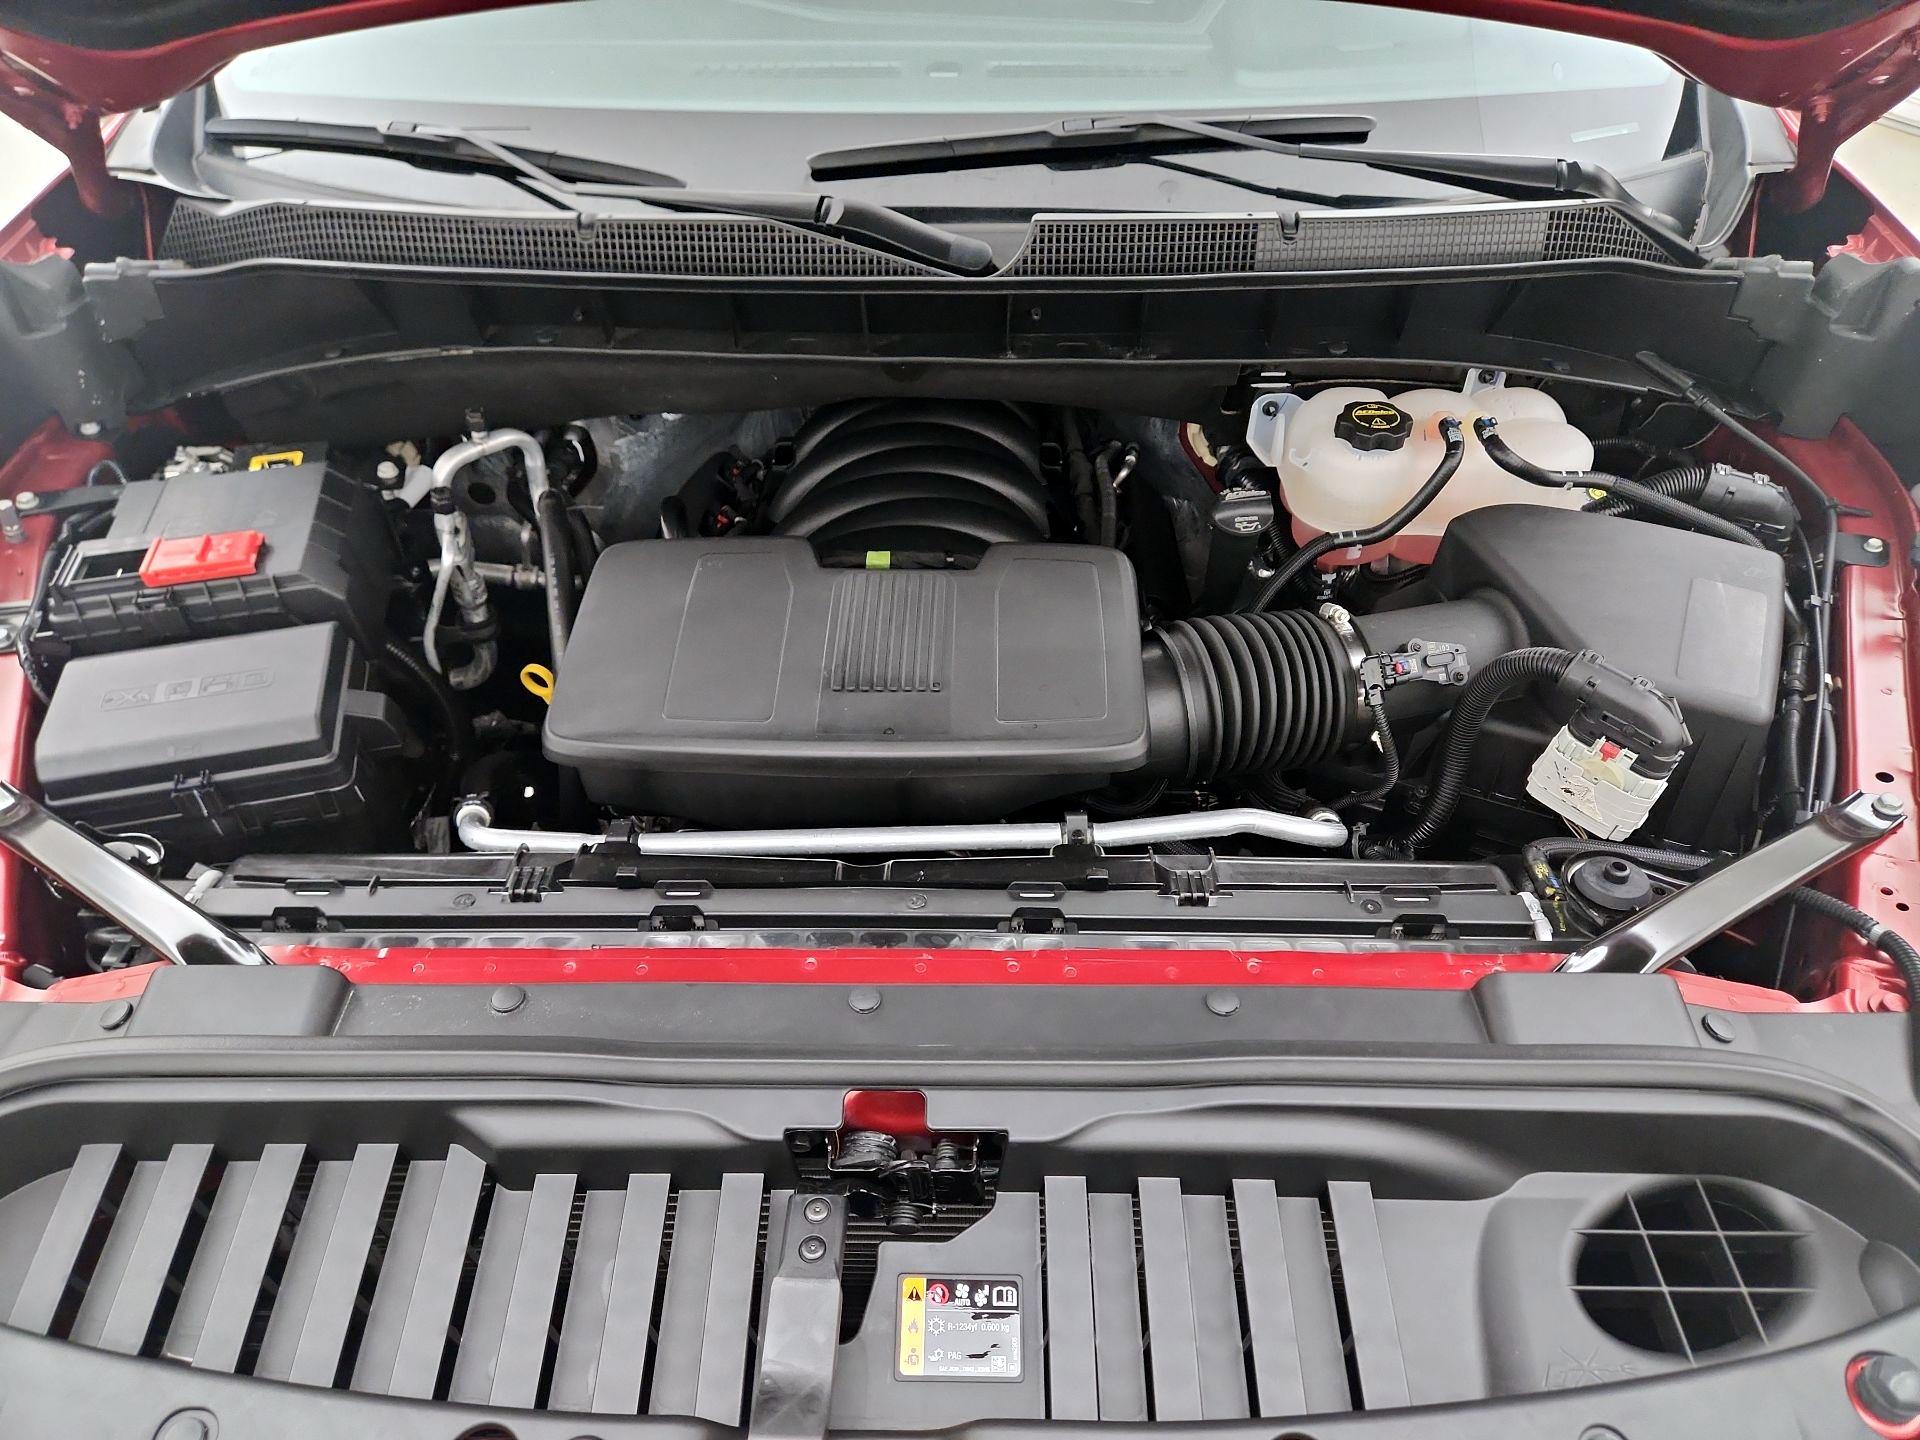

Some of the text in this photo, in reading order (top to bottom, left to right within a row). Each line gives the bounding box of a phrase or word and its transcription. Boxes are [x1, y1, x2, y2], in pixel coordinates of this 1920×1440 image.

[947, 1322, 1010, 1333] R-1234yf 0.600 kg
[947, 1351, 962, 1360] PAG
